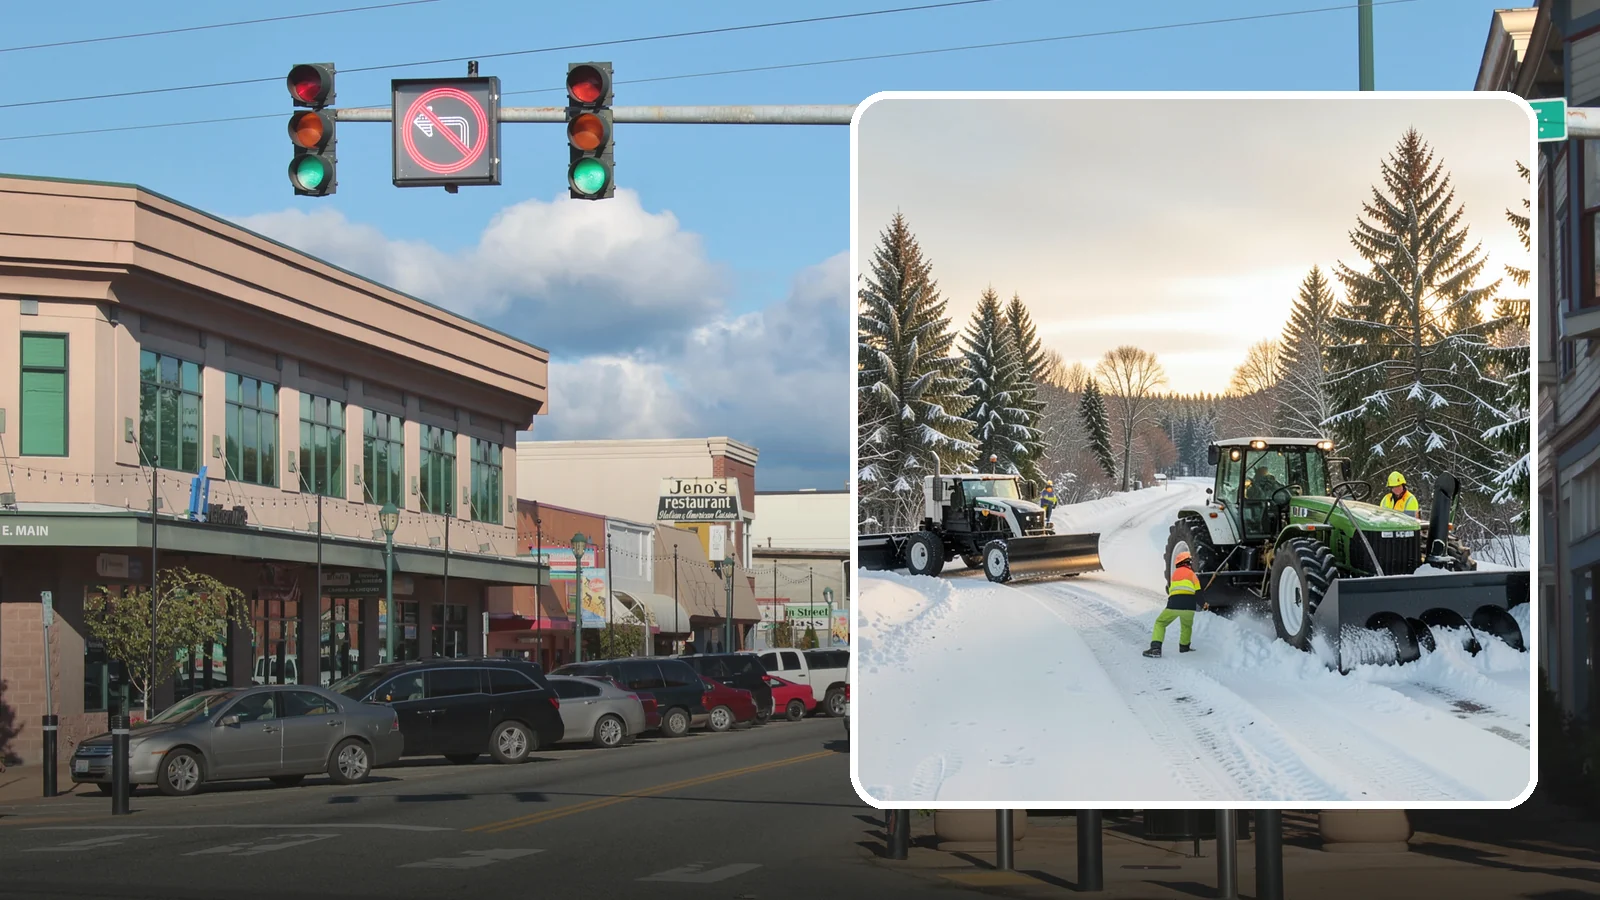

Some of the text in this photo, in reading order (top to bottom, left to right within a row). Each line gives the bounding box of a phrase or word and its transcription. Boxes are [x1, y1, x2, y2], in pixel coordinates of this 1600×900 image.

[669, 480, 728, 494] Jeno's
[665, 496, 731, 509] restaurant
[658, 509, 681, 520] Italian
[685, 509, 714, 519] American
[714, 509, 738, 519] Cuisine
[2, 525, 49, 536] E. MAIN
[797, 607, 829, 617] Street
